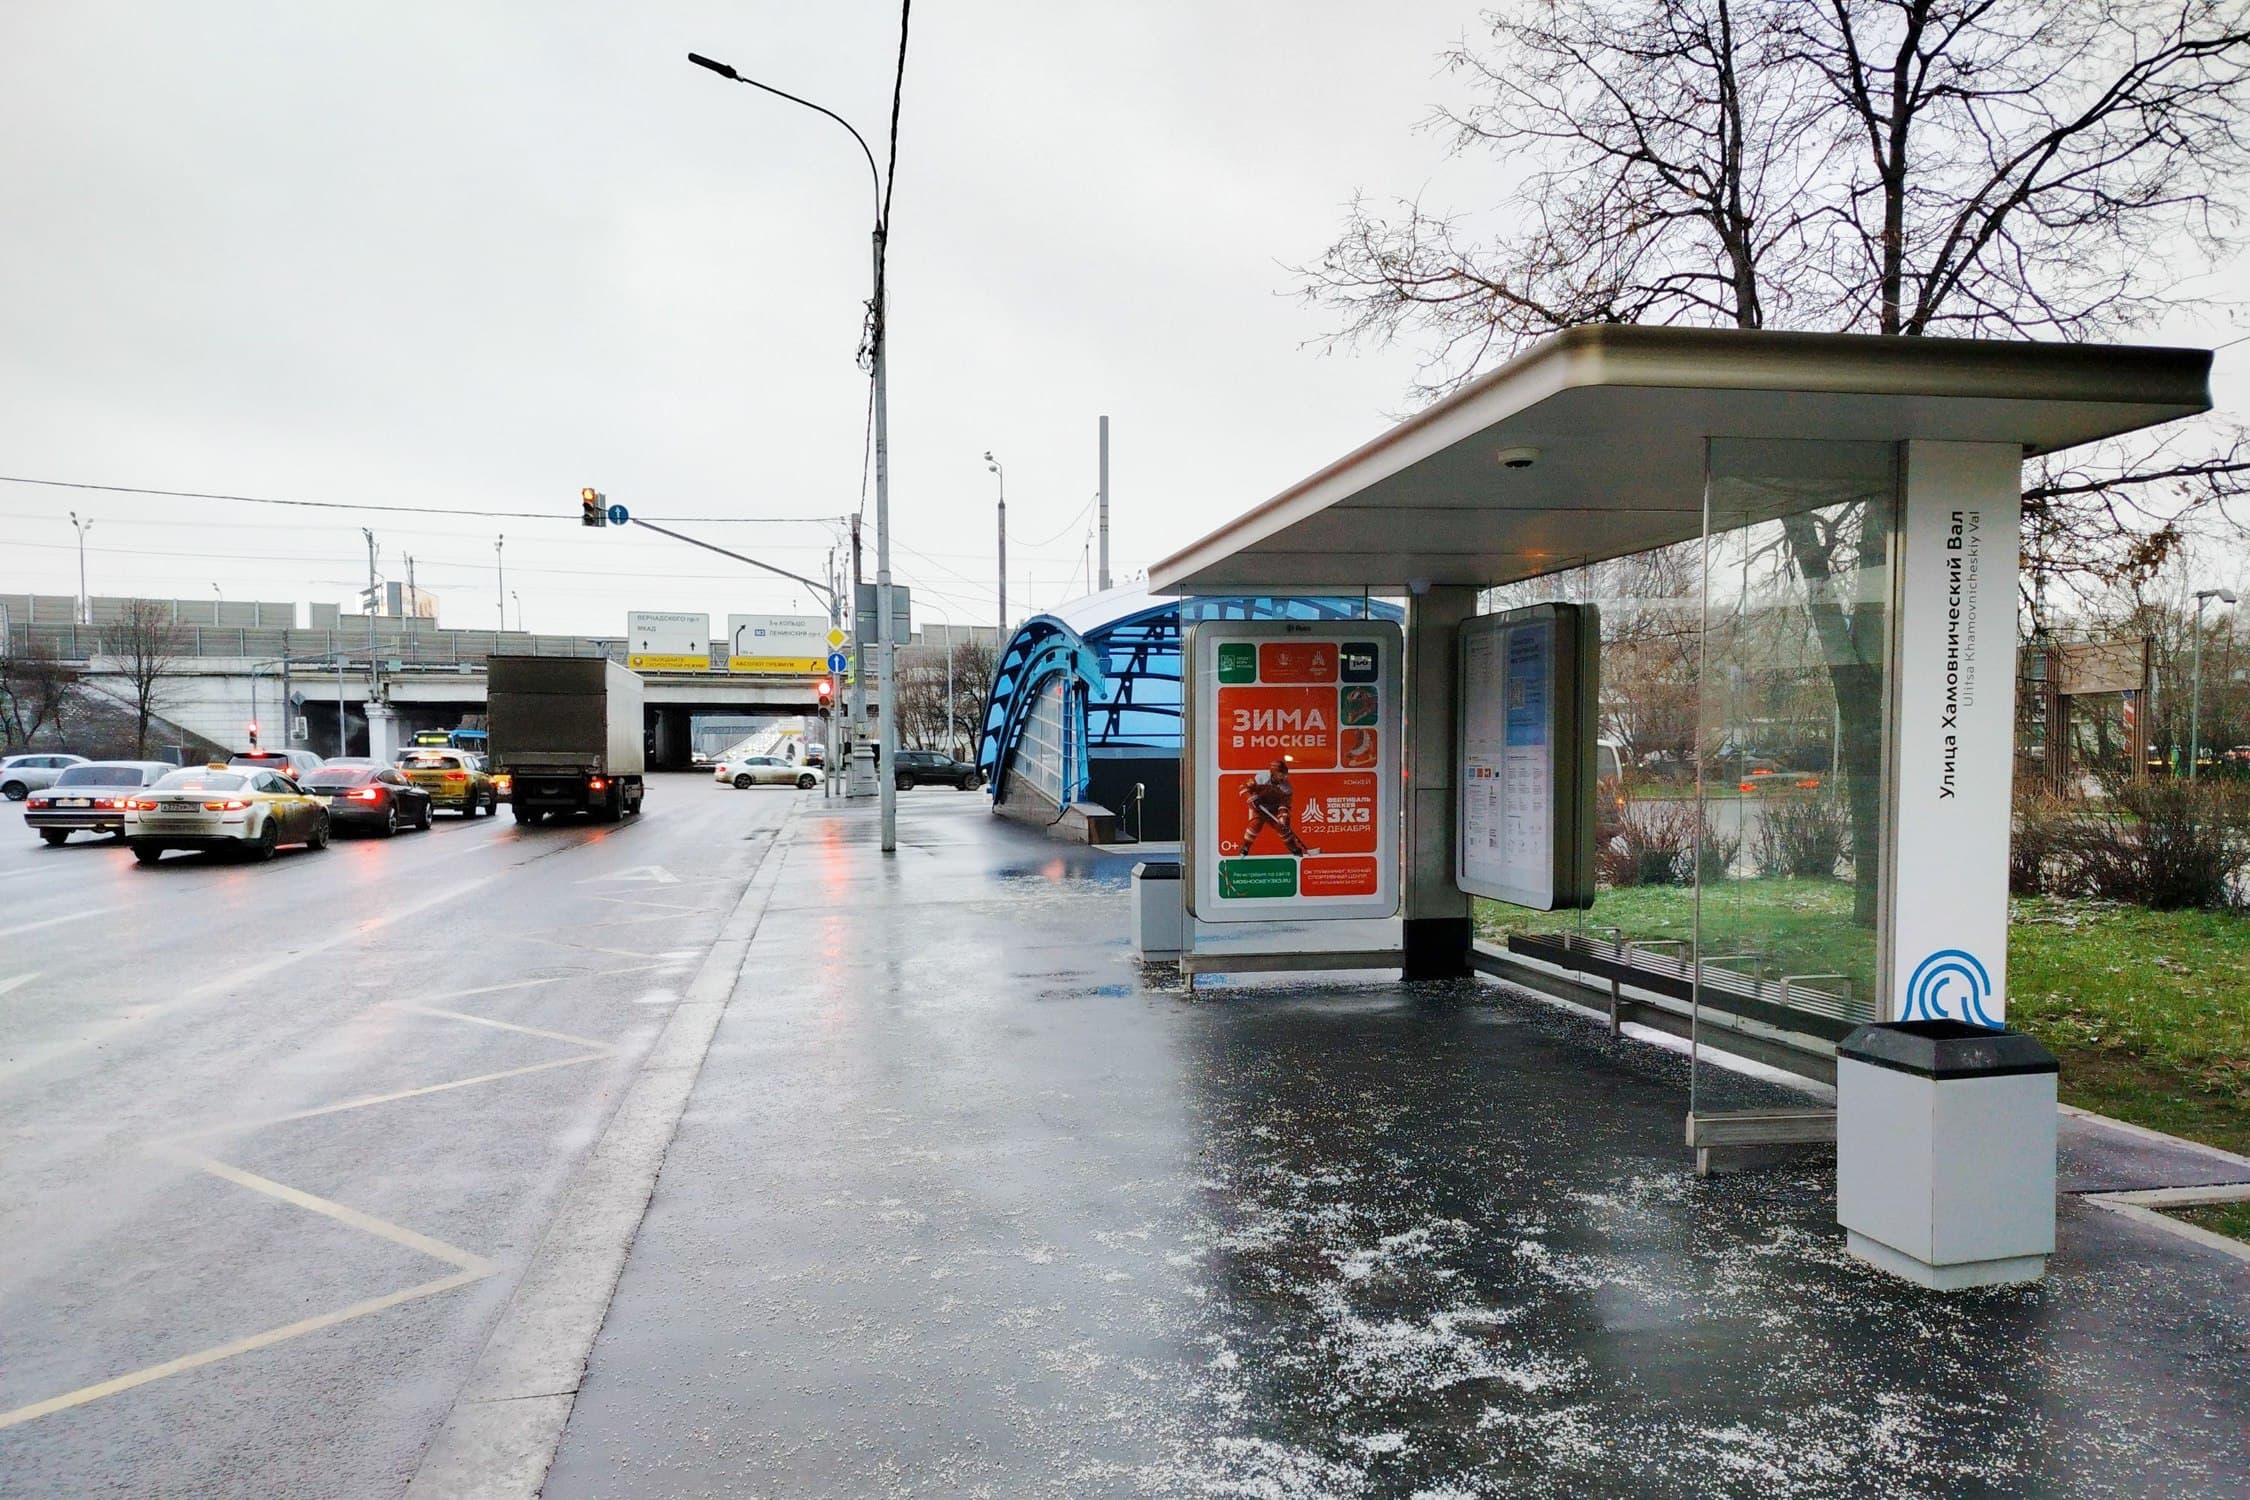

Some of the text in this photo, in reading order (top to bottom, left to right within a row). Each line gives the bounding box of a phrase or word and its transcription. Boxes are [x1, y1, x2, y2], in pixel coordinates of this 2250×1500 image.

[1963, 511, 1981, 706] Ulitsa Khamovnicheskiy Val
[1940, 511, 1963, 799] Улица Хамовнический Вал
[1232, 708, 1327, 731] ЗИМА
[1232, 734, 1327, 748] В МОСКВЕ
[1327, 824, 1371, 833] ДЕКАБРЯ
[1221, 840, 1239, 851] 0+
